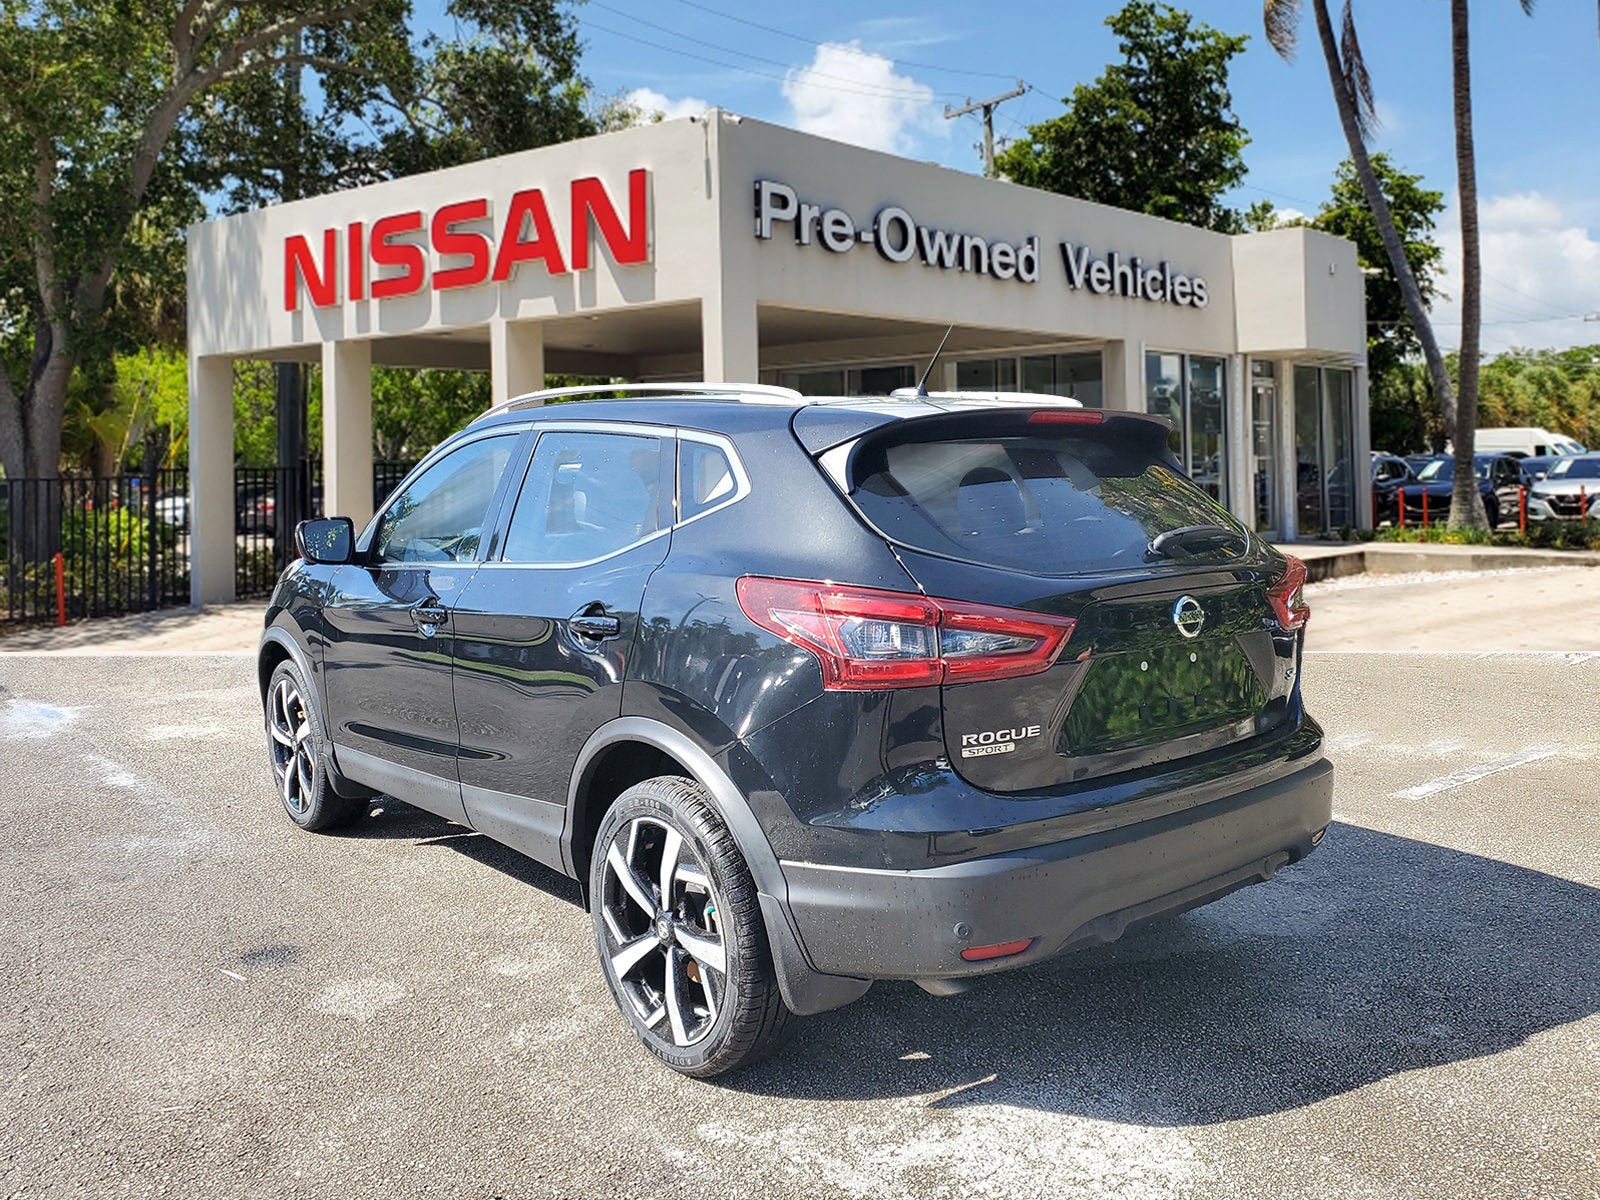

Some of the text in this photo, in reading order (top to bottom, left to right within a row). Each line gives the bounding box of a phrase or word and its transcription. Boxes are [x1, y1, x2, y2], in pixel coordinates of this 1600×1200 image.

[285, 169, 648, 311] NISSAN
[755, 180, 1209, 308] Pre-Owned Vehicles
[961, 725, 1041, 746] ROGUE
[968, 744, 1011, 756] SPORT
